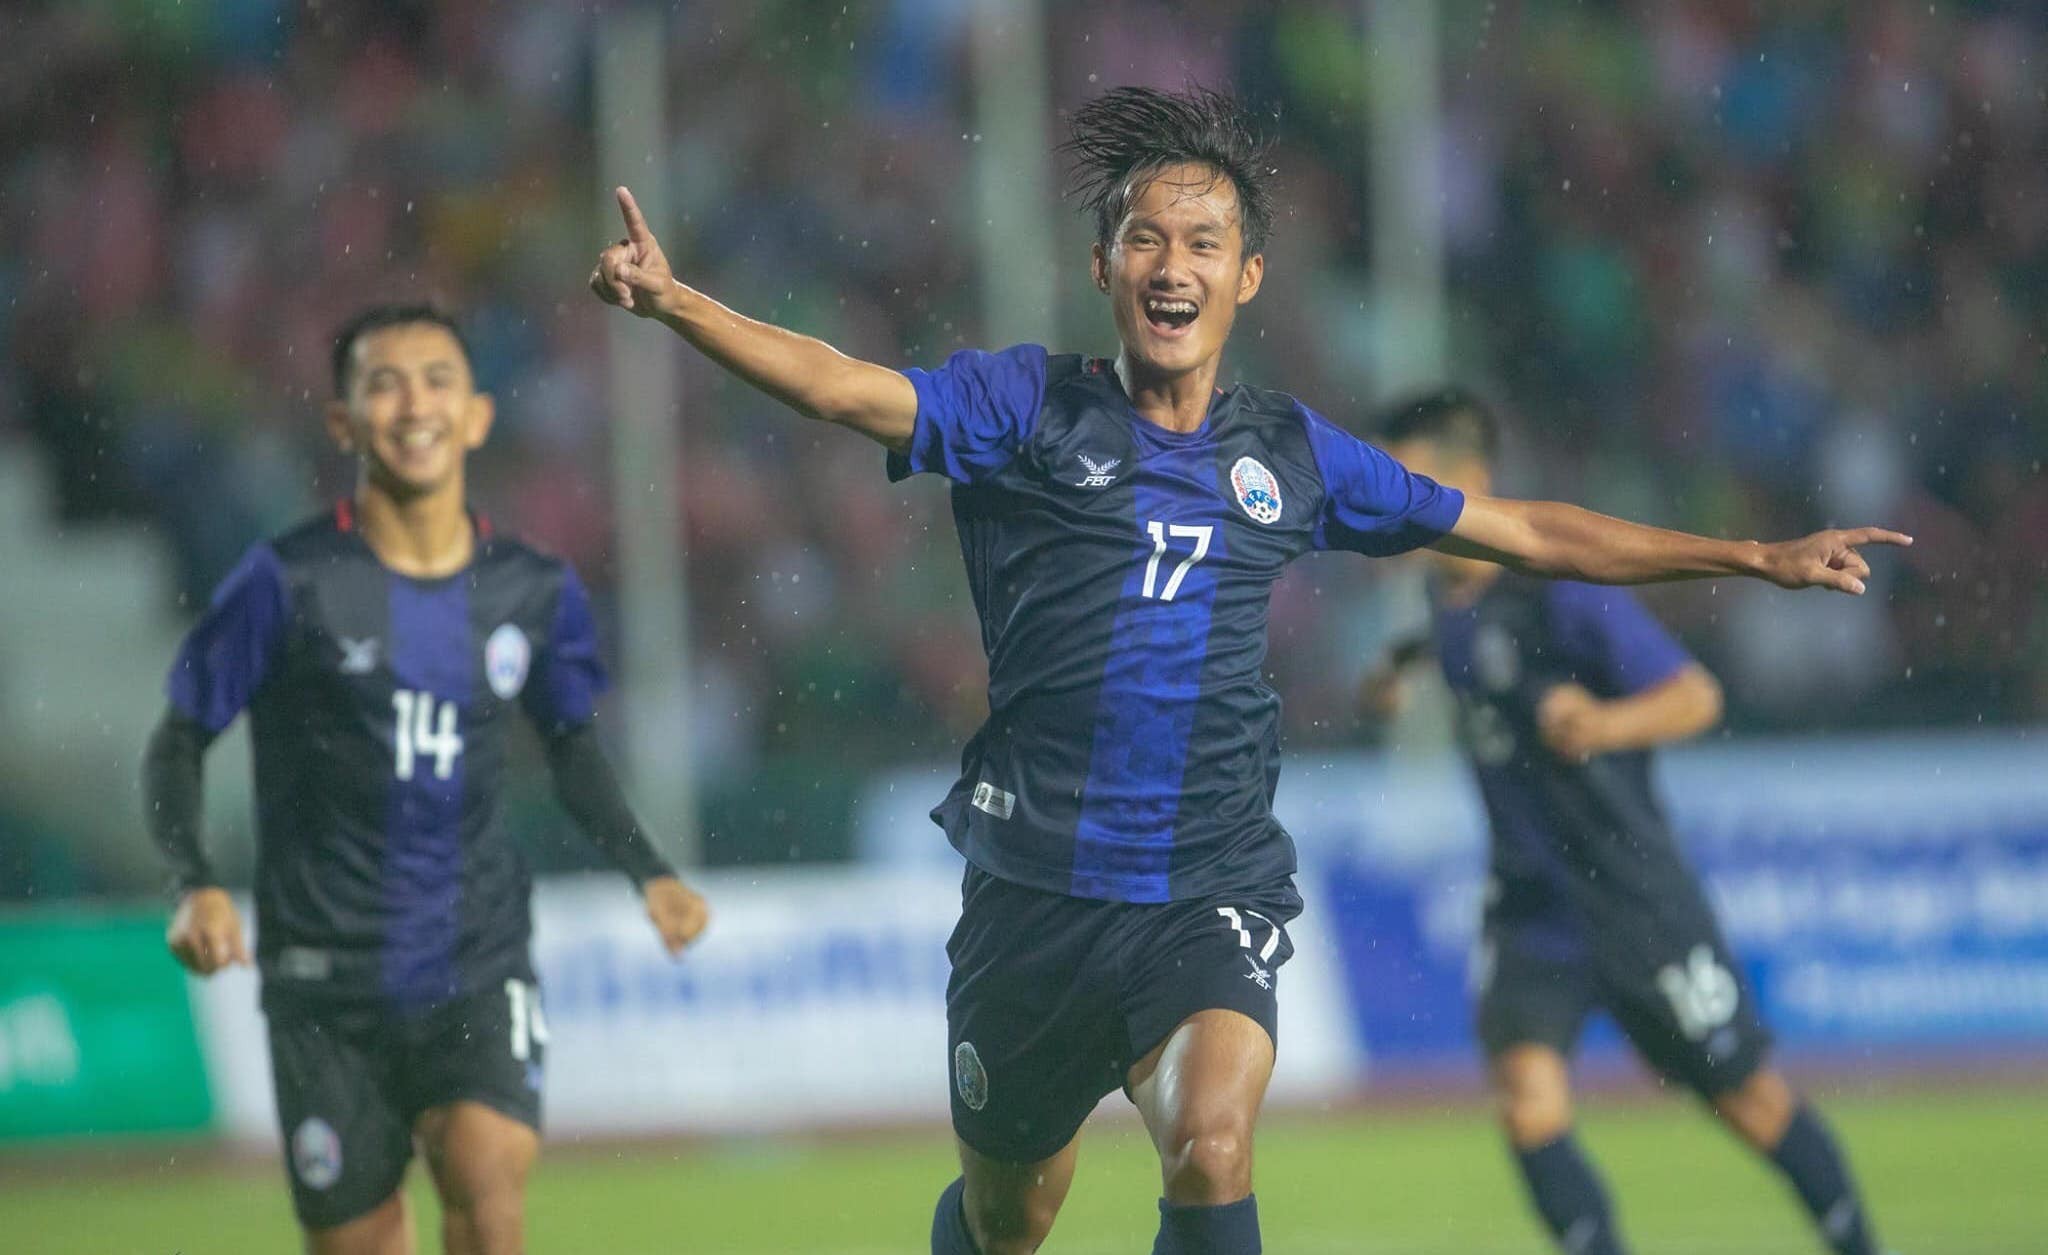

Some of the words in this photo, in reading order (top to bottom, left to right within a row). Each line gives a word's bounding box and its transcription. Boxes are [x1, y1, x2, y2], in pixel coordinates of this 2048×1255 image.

[1075, 475, 1117, 487] FBT
[1142, 520, 1214, 601] 17
[391, 688, 465, 781] 14
[1216, 907, 1280, 964] 17
